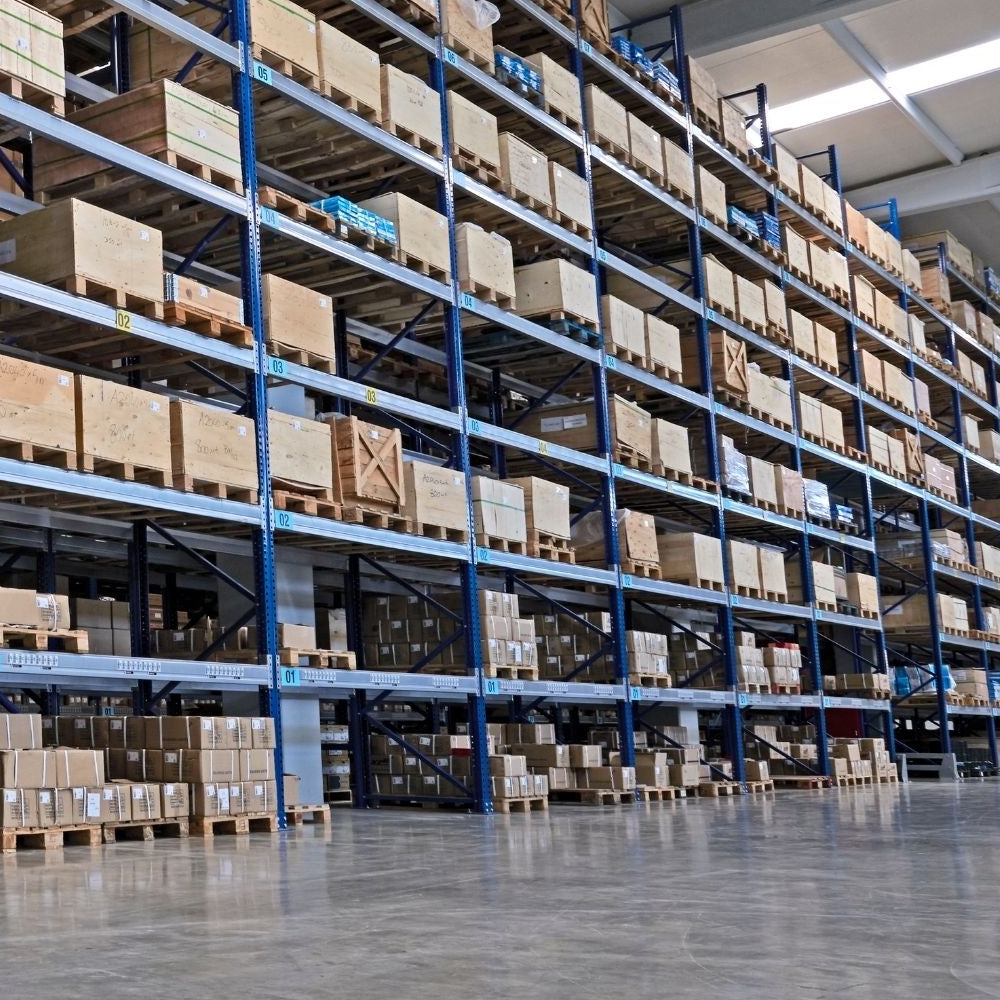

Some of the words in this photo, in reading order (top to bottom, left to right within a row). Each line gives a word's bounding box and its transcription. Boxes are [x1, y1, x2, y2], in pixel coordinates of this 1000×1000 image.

[257, 65, 268, 82] 05
[265, 209, 275, 225] 04
[465, 296, 471, 307] 04
[118, 313, 130, 329] 02
[273, 358, 284, 374] 03
[367, 390, 376, 405] 03
[472, 420, 479, 432] 03
[279, 514, 290, 528] 02
[480, 550, 488, 561] 02
[286, 670, 295, 684] 01
[488, 682, 495, 693] 01
